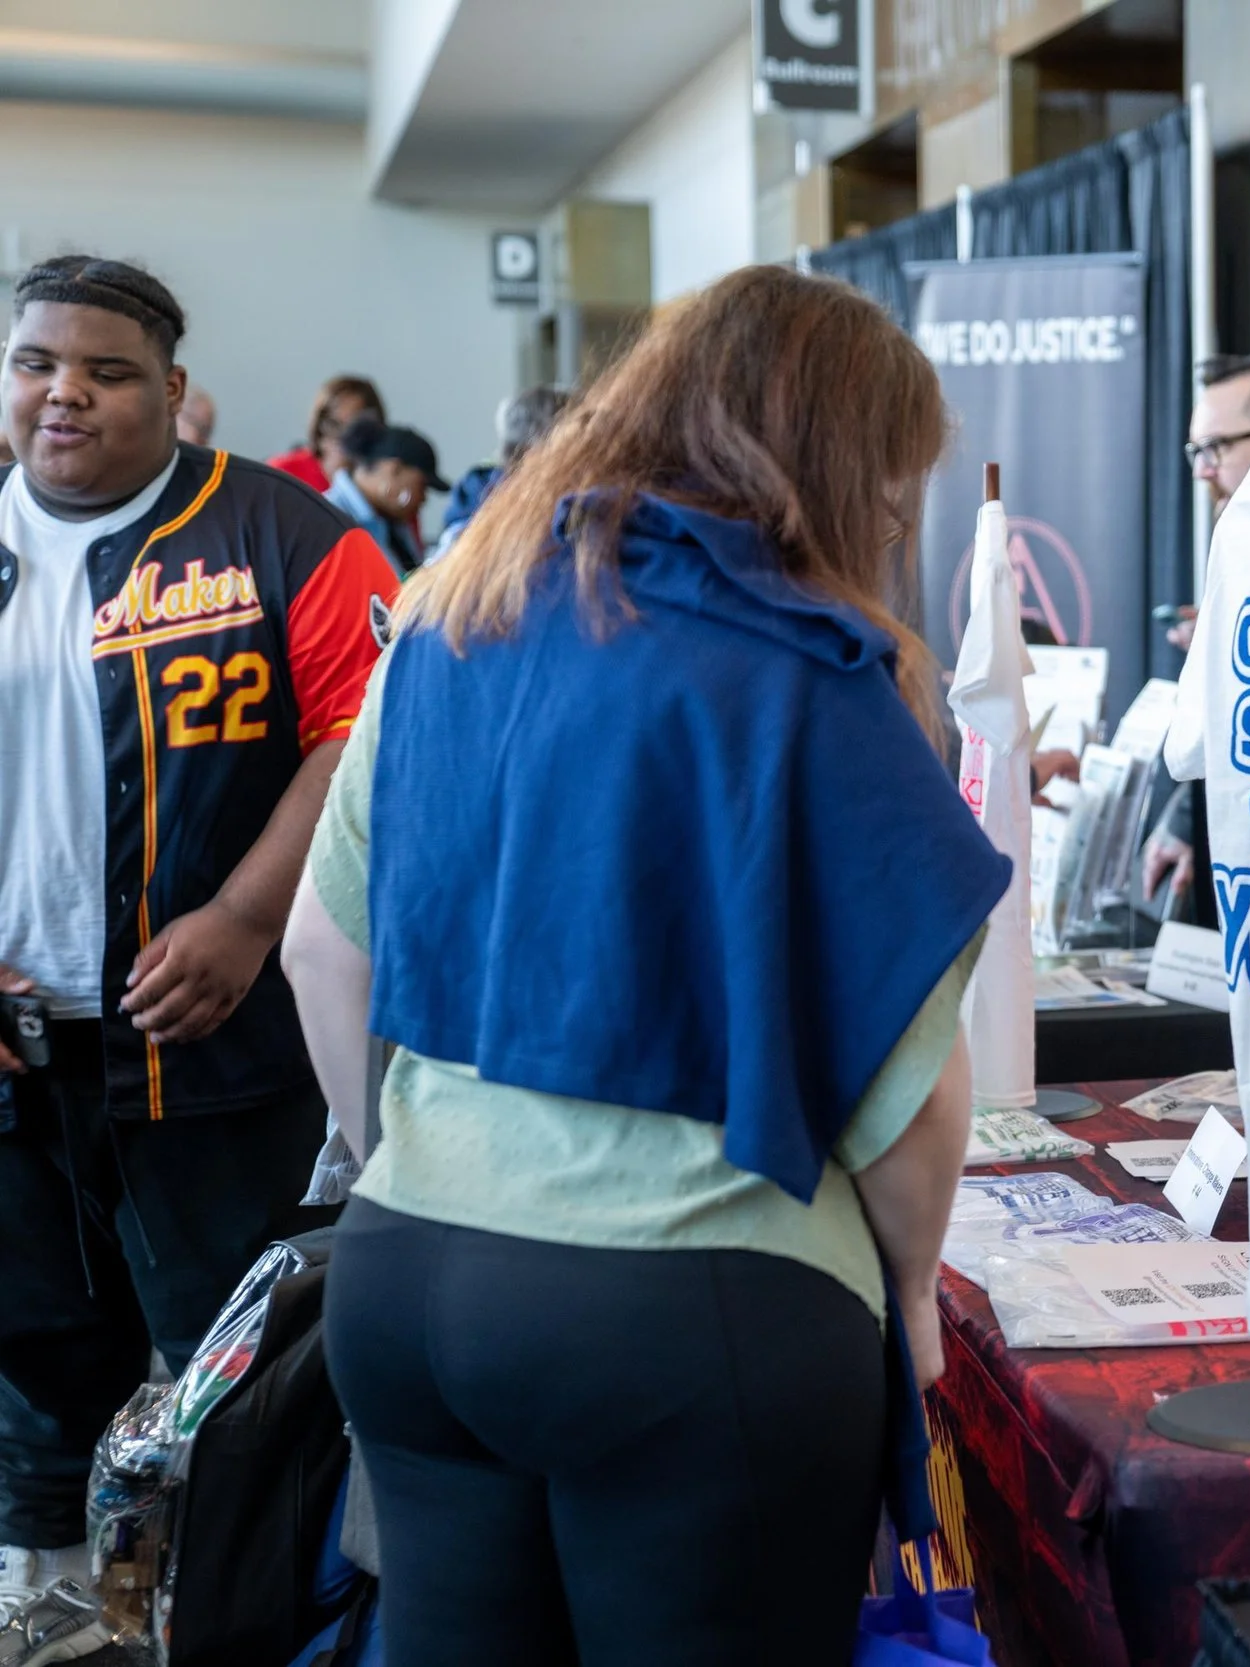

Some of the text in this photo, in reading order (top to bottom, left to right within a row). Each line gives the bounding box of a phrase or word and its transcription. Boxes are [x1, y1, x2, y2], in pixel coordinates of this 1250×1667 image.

[778, 0, 843, 49] C
[496, 236, 534, 279] D
[969, 319, 1011, 365] DO
[93, 559, 262, 640] Maker
[160, 650, 271, 749] 22
